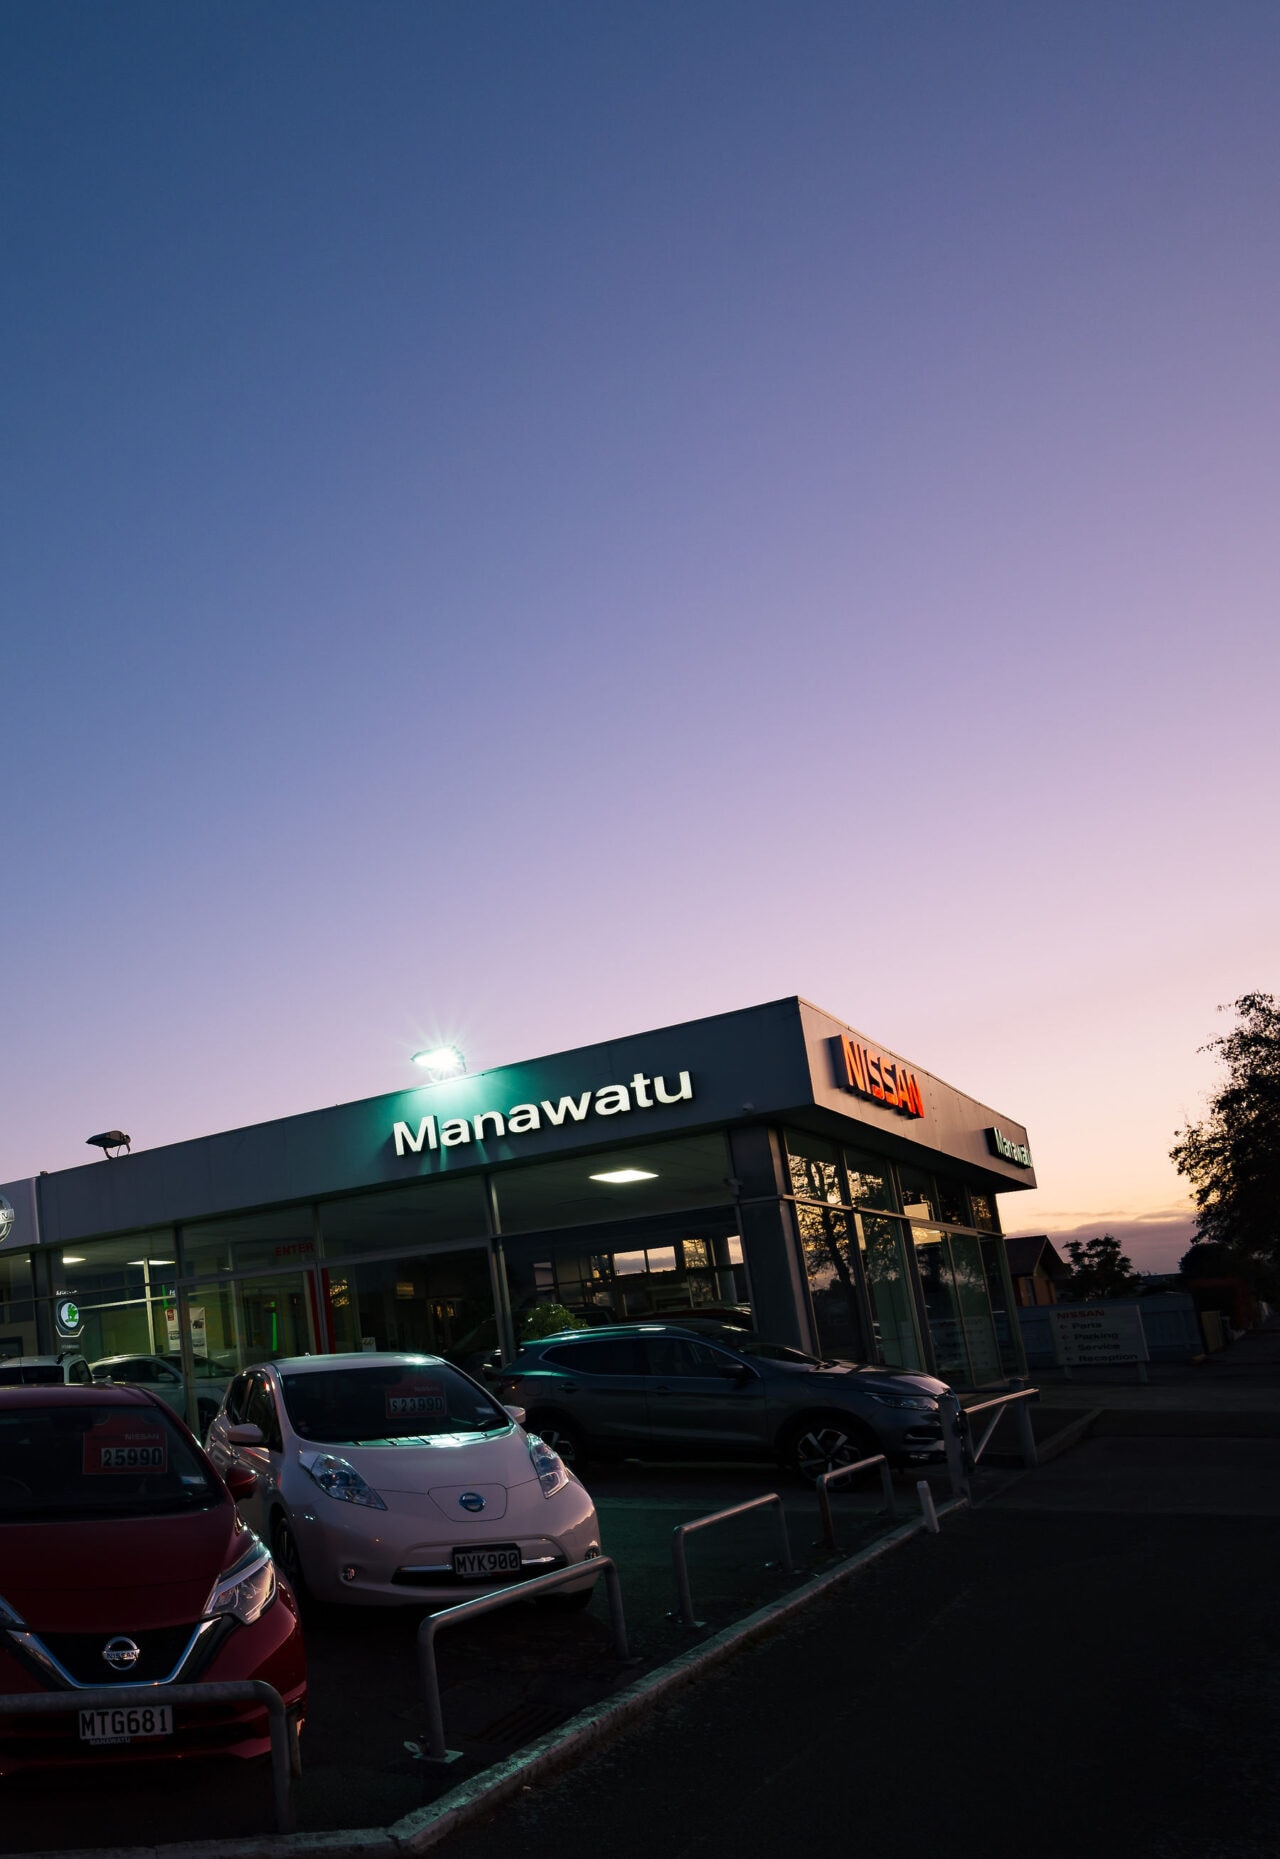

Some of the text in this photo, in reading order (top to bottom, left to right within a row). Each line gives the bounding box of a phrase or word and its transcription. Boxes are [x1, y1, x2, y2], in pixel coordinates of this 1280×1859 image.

[840, 1035, 925, 1118] NISSAN
[392, 1070, 694, 1157] Manawatu
[275, 1241, 315, 1257] ENTER
[1056, 1309, 1105, 1319] NISSAN
[1071, 1321, 1102, 1330] Parts
[1073, 1332, 1119, 1341] Parking
[1077, 1343, 1121, 1351] Service
[1078, 1352, 1138, 1362] Reception
[102, 1447, 163, 1467] 25990
[455, 1552, 519, 1573] MYK900
[81, 1708, 168, 1737] MTG681
